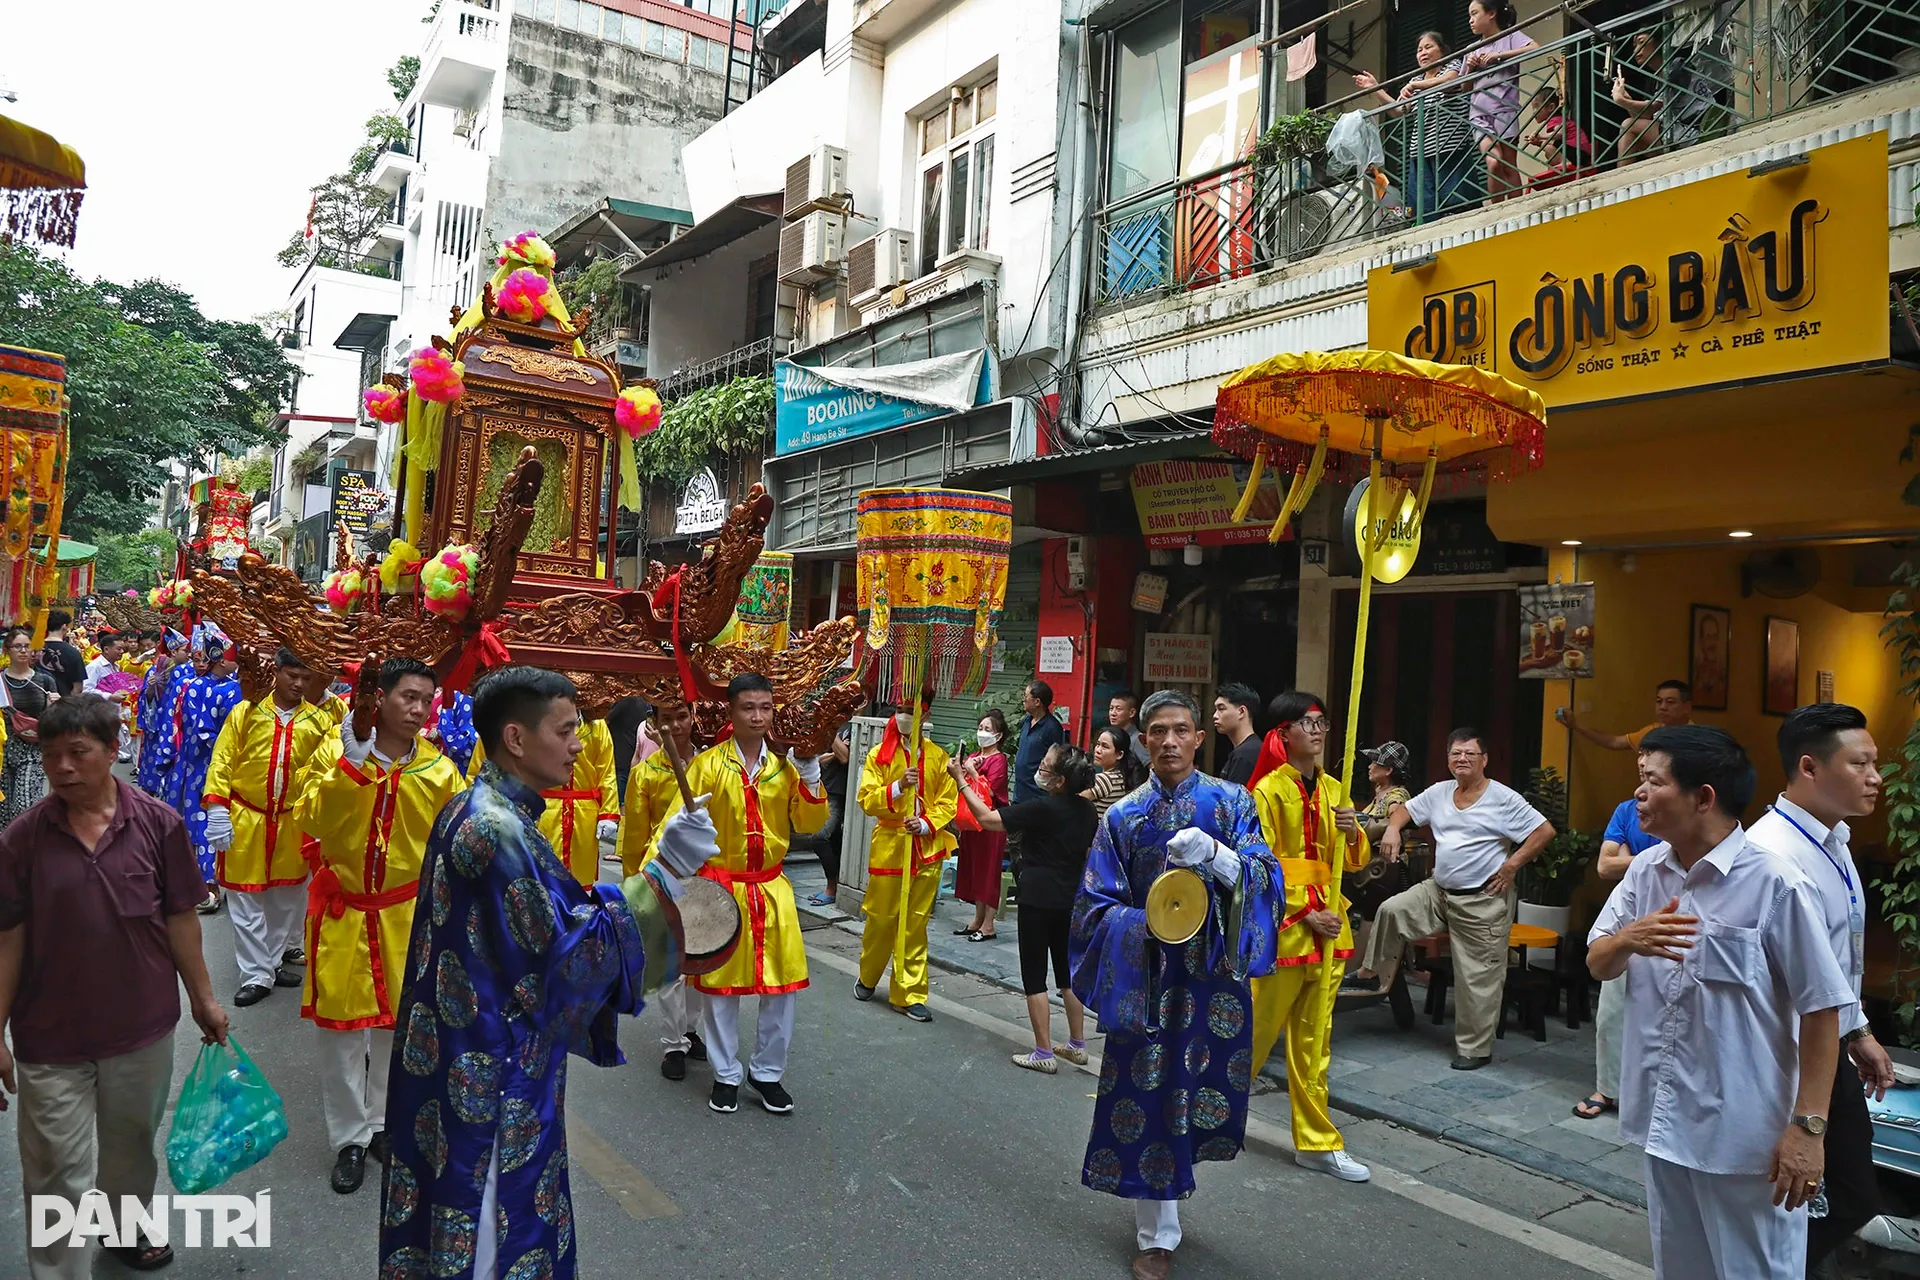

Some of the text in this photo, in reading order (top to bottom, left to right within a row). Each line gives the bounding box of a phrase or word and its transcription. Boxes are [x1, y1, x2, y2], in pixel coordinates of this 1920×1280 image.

[1509, 199, 1821, 374] ÔNG BẦU
[1576, 321, 1821, 375] SỐNG THẬT CÀ PHÊ THẬT
[1459, 349, 1487, 366] CAFÉ
[807, 392, 877, 426] BOOKING
[902, 407, 916, 419] Tel:
[801, 431, 811, 444] 49
[811, 433, 827, 442] Hang
[827, 429, 836, 439] Be
[340, 475, 367, 488] SPA
[359, 494, 380, 504] FOOT
[359, 502, 380, 511] BODY
[677, 507, 724, 527] PIZZA BELGA
[1237, 530, 1251, 538] 036
[1252, 528, 1266, 537] 730
[1162, 536, 1170, 545] 51
[1307, 549, 1321, 562] 51
[1149, 638, 1161, 647] 51
